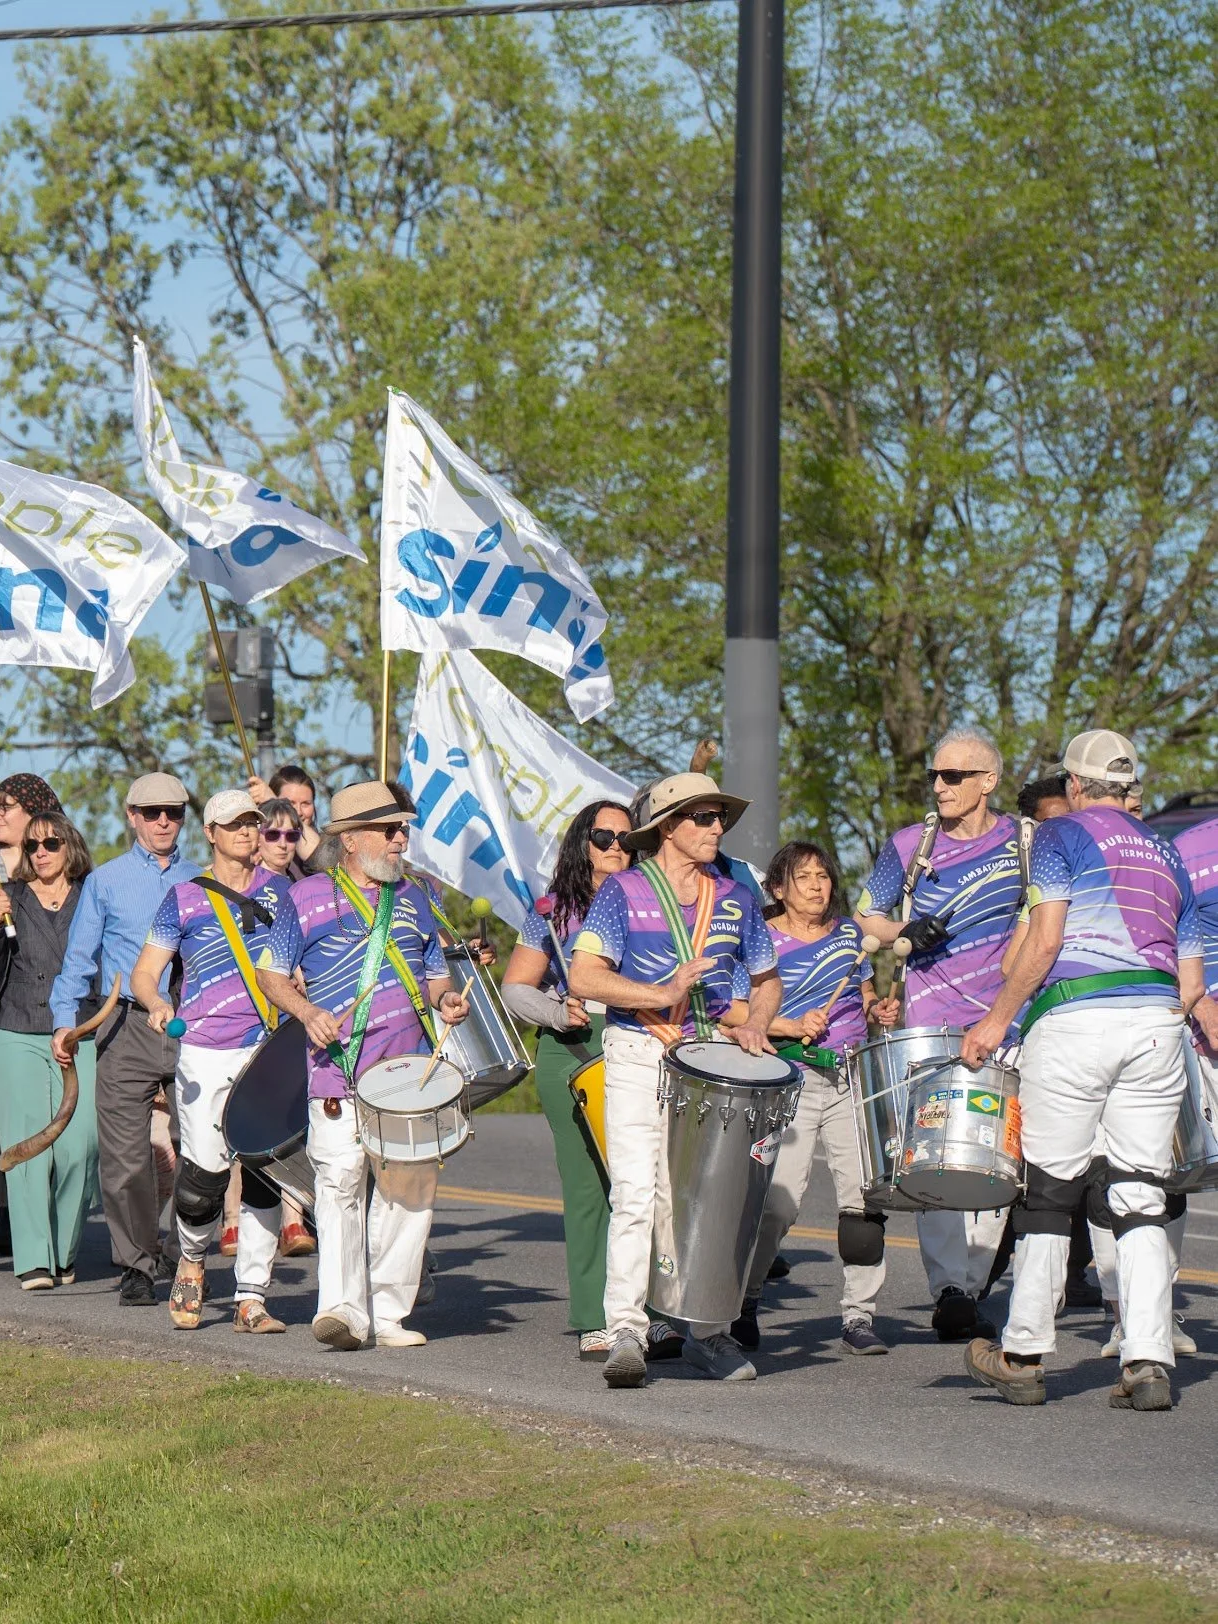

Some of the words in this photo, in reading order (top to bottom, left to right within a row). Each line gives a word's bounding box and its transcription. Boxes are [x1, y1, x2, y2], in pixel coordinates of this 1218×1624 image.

[394, 520, 588, 652] Sin
[1097, 834, 1178, 869] BURLINGTON
[1119, 848, 1167, 867] VERMONT
[708, 922, 740, 934] UCADA!
